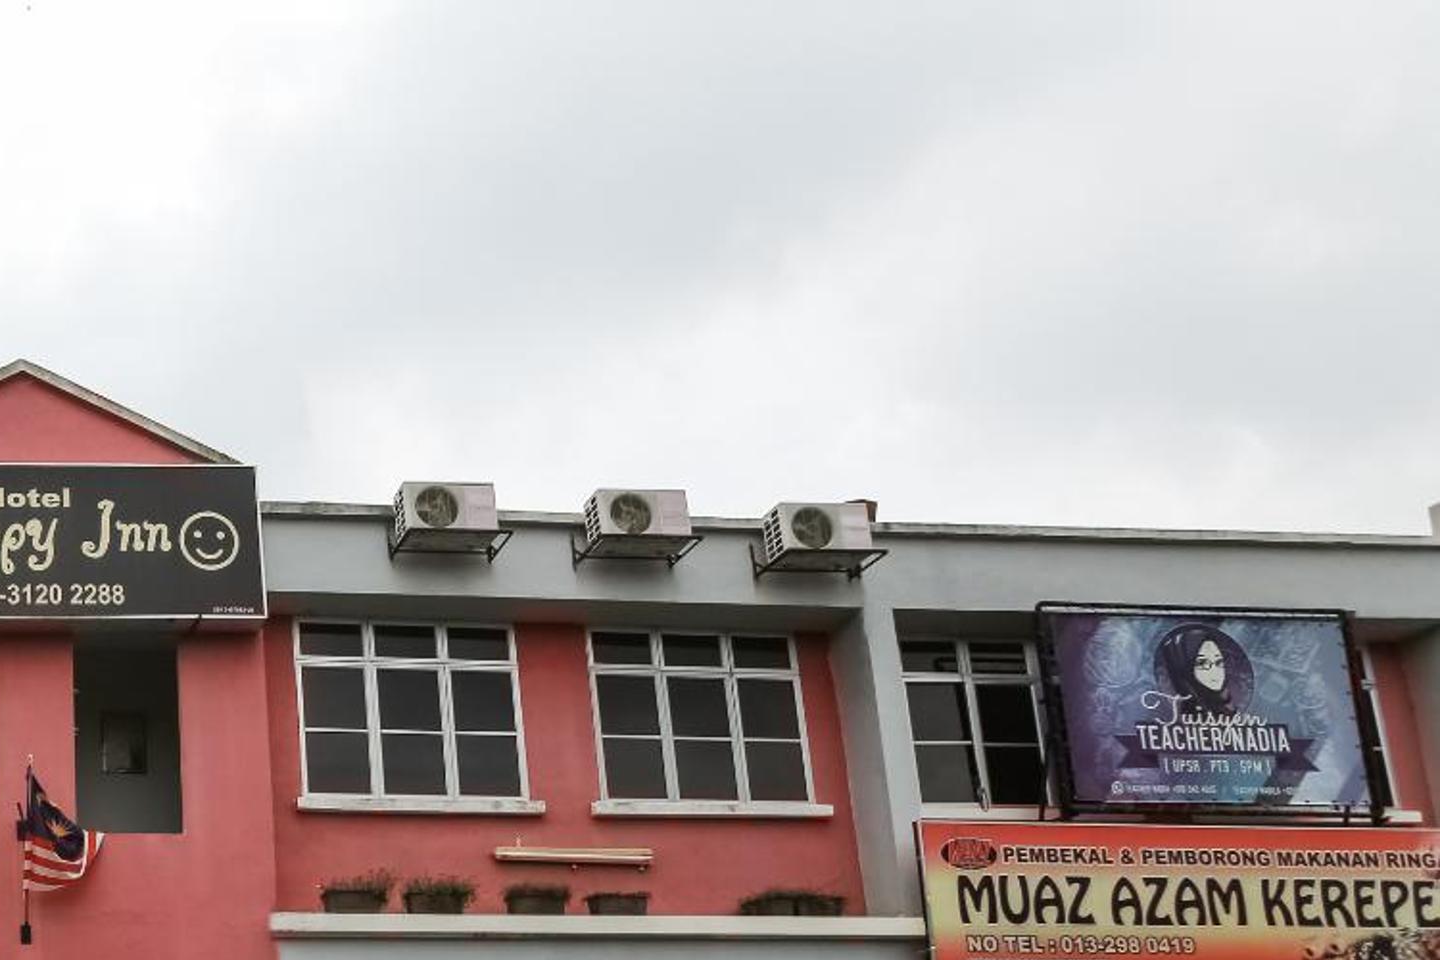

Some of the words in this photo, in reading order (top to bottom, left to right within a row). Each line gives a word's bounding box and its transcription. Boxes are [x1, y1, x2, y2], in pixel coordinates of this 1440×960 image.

[81, 499, 172, 558] Inn
[70, 584, 125, 605] 2288
[1141, 690, 1268, 746] Tuisyen
[1136, 725, 1224, 751] TEACHER
[1232, 727, 1291, 753] NADIA
[1003, 847, 1114, 864] PEMBEKAL
[1120, 848, 1135, 864] &
[1142, 848, 1270, 867] PEMBORONG
[1277, 851, 1379, 868] MAKANAN
[1386, 852, 1440, 868] RING
[957, 875, 1096, 925] MUAZ
[1111, 876, 1248, 926] AZAM
[1261, 878, 1440, 928] KEREPE
[966, 936, 999, 953] NO
[1061, 937, 1141, 954] 013-298
[1146, 937, 1195, 955] 0419
